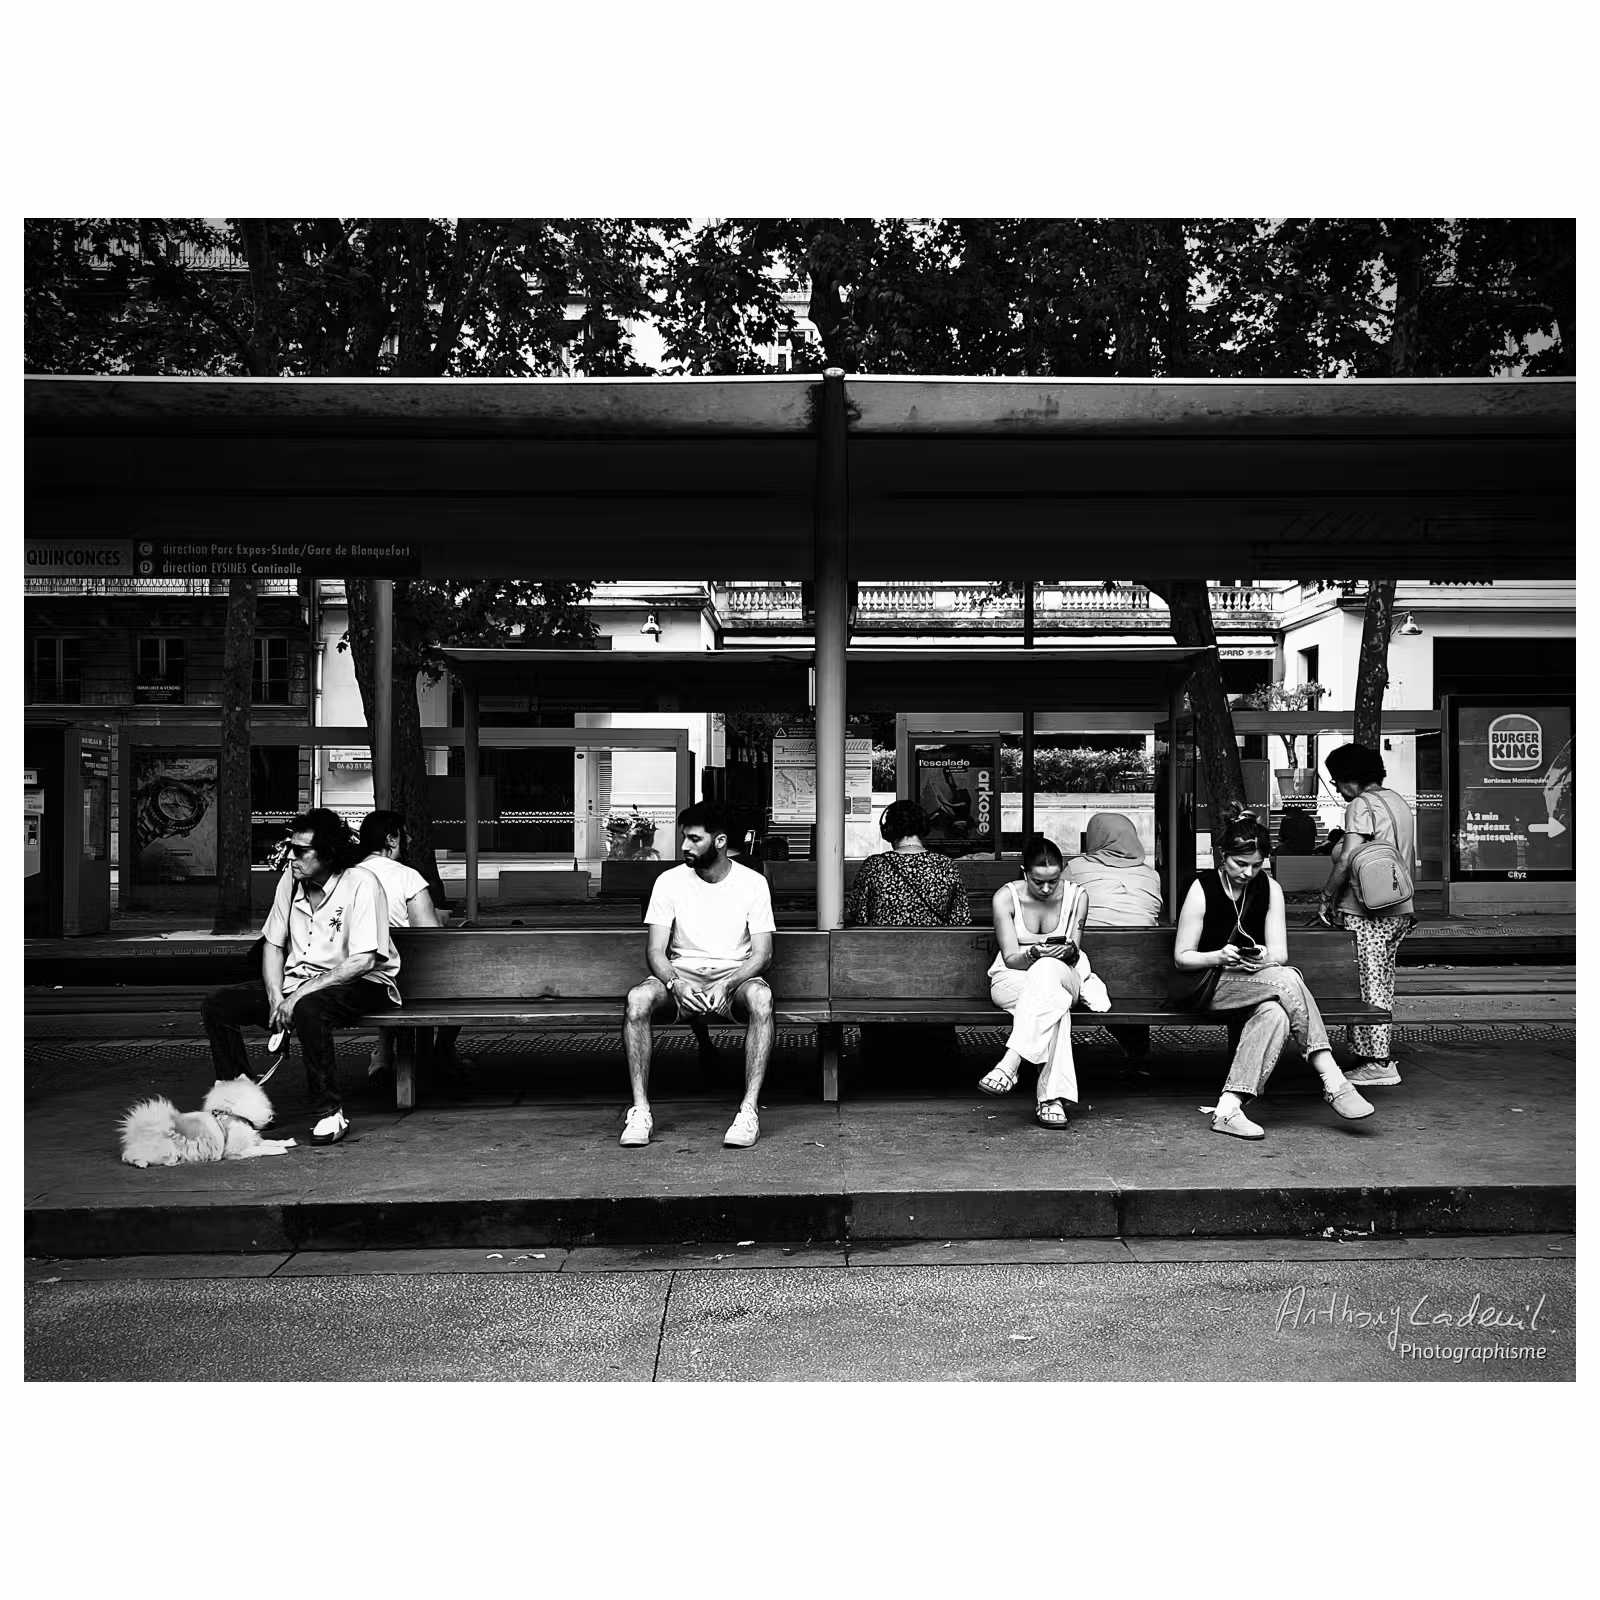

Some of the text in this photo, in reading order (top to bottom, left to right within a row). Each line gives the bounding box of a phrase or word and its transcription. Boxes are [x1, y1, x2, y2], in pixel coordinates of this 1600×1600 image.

[26, 550, 120, 566] QUINCONCES
[162, 544, 208, 555] direction
[211, 544, 233, 555] Parc
[237, 544, 332, 557] Expos-Stade/Gare
[336, 544, 347, 555] de
[352, 544, 411, 558] Blanquefort
[140, 560, 303, 575] D direction EYSINES Cantinolle
[1492, 733, 1539, 744] BURGER
[1492, 744, 1540, 759] KING
[919, 759, 970, 767] l'escalade
[977, 771, 994, 835] arkose
[1466, 810, 1499, 821] À 2 min
[1466, 822, 1510, 831] Bordeaux
